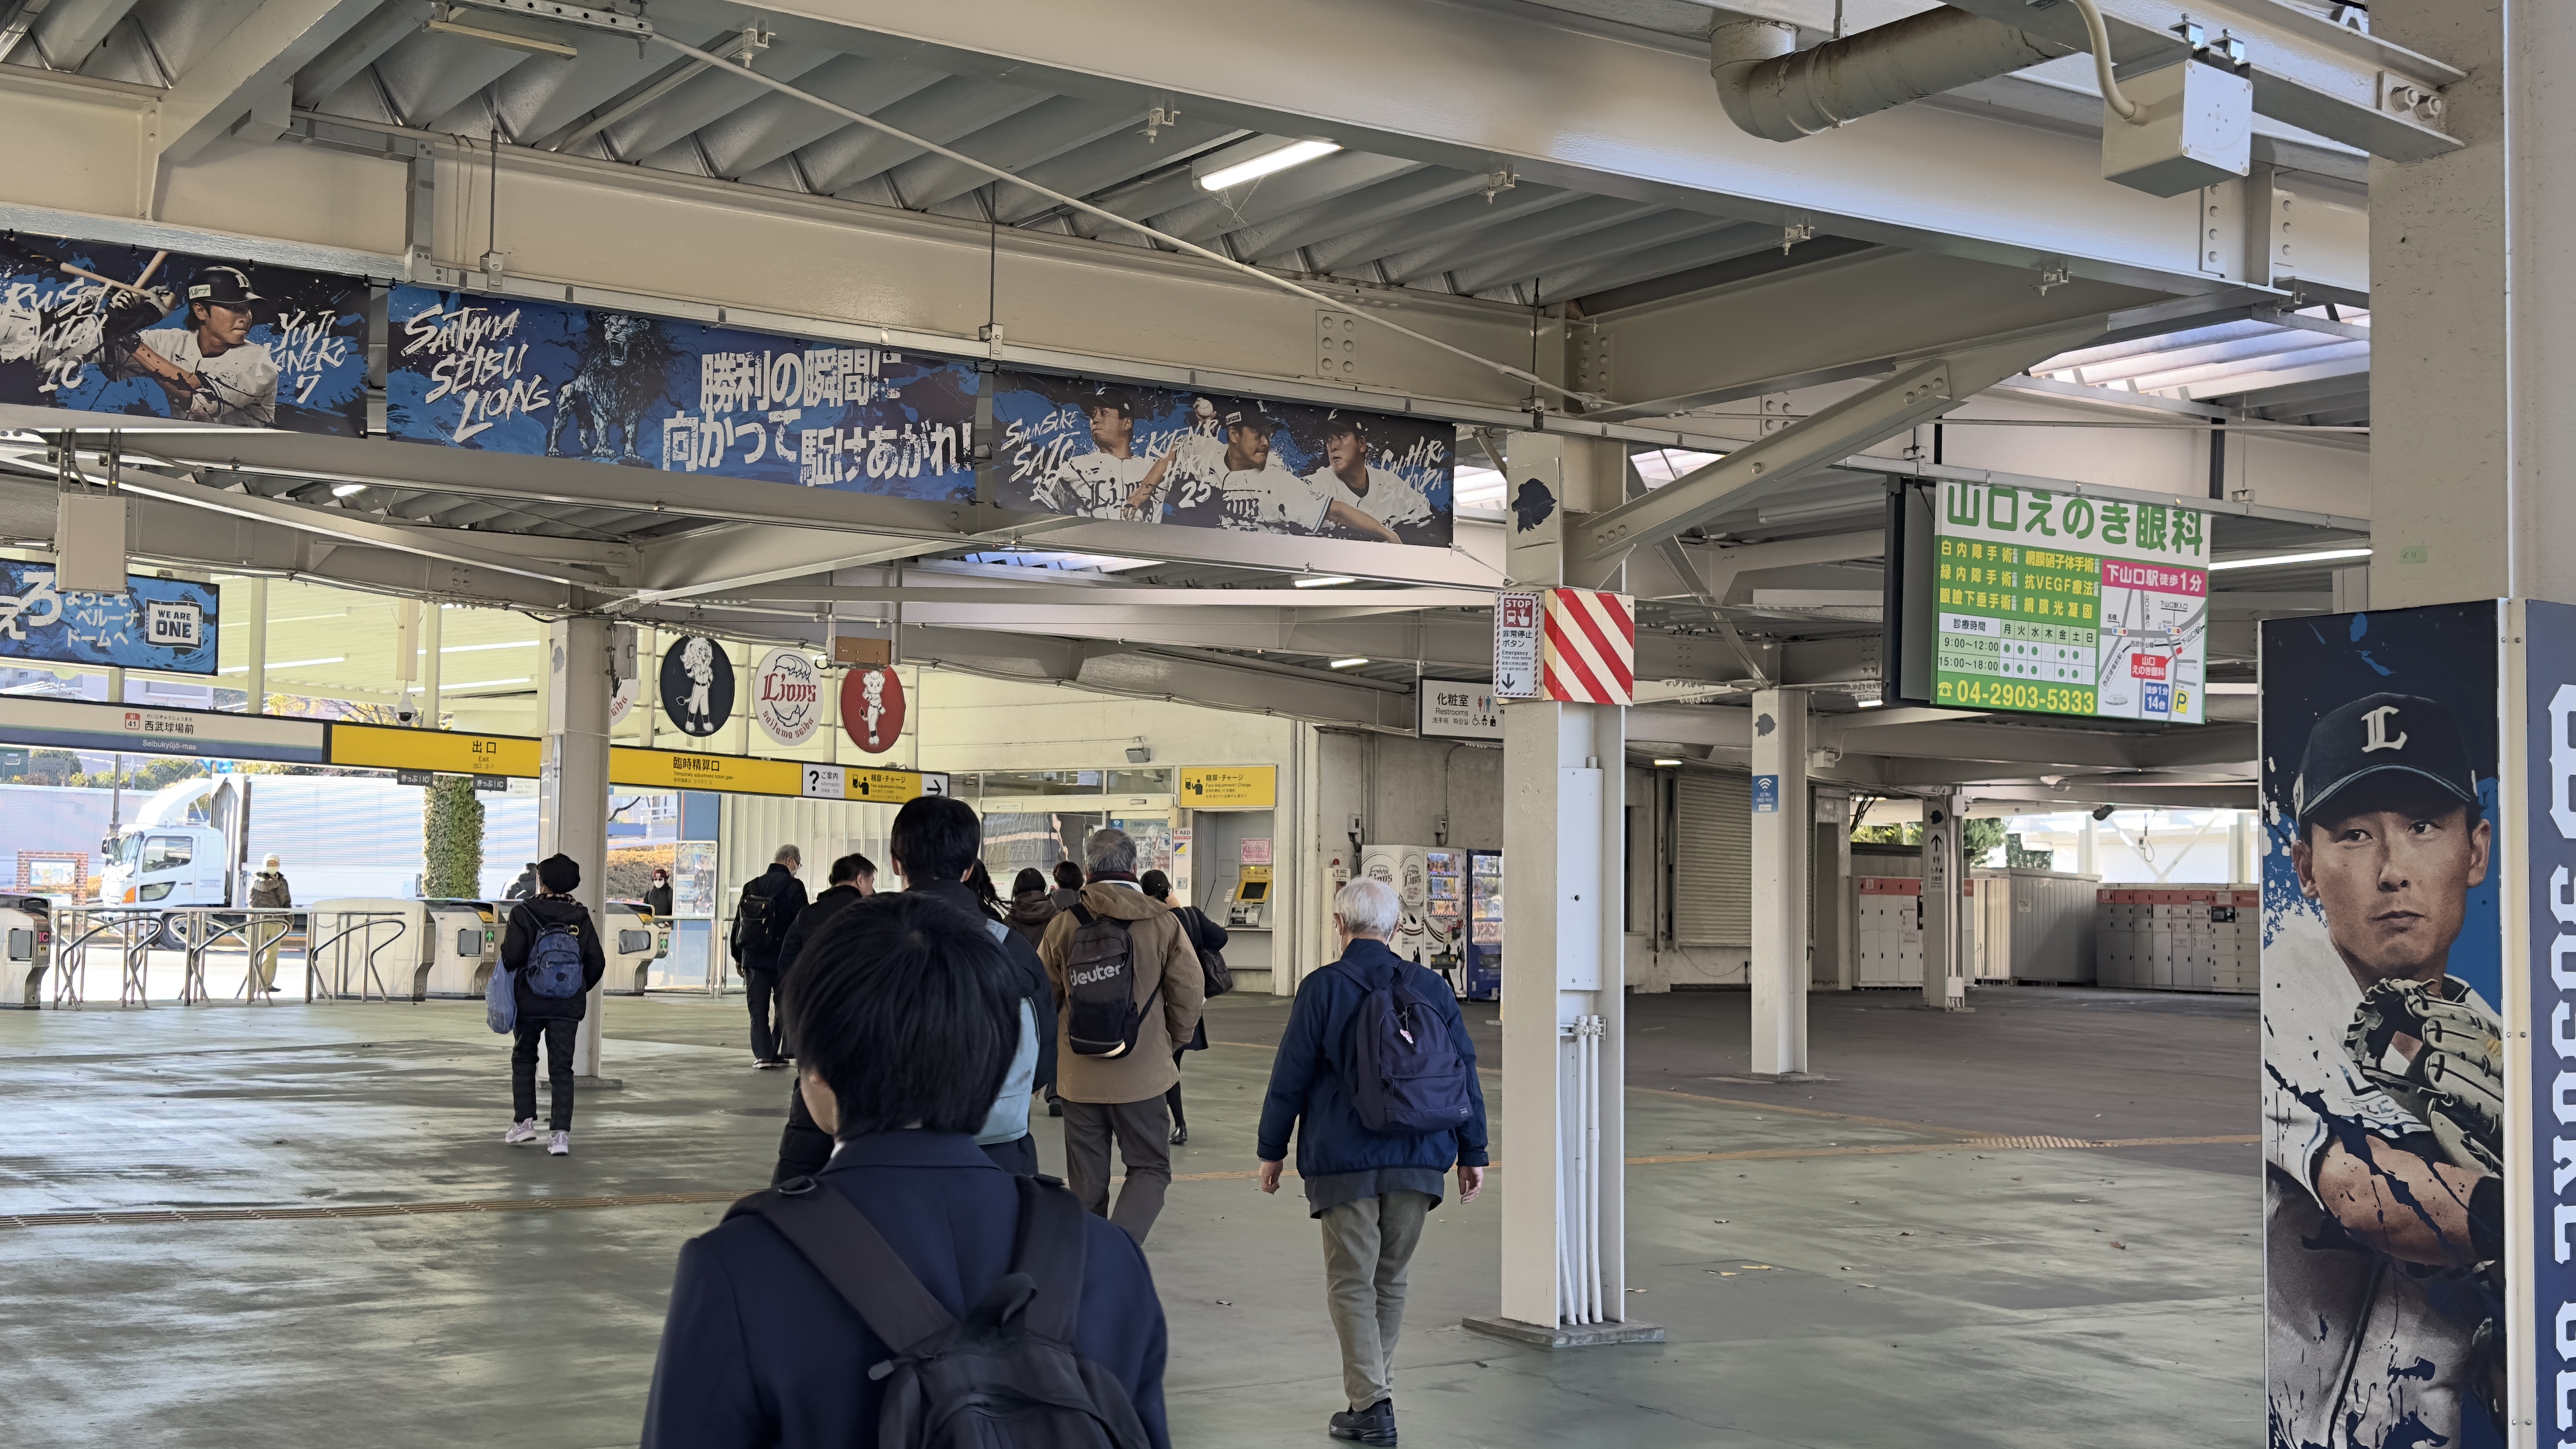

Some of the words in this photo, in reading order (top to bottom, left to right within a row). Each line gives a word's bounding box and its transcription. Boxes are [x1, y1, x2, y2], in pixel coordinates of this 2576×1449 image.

[400, 304, 520, 356] SAITAMA
[425, 343, 529, 405] SEIBU
[700, 348, 902, 413] 勝利の瞬間に
[296, 374, 322, 404] 7
[452, 375, 551, 443] LIONS
[662, 408, 801, 472] 向かって
[1009, 431, 1080, 483] SATO
[1178, 477, 1211, 509] 25
[1948, 480, 2203, 557] 山口えのき眼科
[1941, 540, 2012, 564] 白内障手術
[2025, 550, 2094, 573] 網膜硝子体手術
[1940, 563, 2012, 587] 緑内障手術
[2025, 573, 2093, 596] 抗VEGF療法
[2106, 564, 2202, 592] 下山口駅徒歩1分
[158, 609, 171, 619] WE
[174, 611, 191, 621] ARE
[1505, 600, 1531, 608] STOP
[76, 608, 140, 627] ベルーナ
[156, 620, 192, 638] ONE
[1953, 618, 1986, 632] 診療時間
[2004, 624, 2011, 634] 月
[2017, 625, 2025, 636] 火
[2031, 628, 2039, 637] 水
[2045, 629, 2053, 637] 木
[2059, 630, 2066, 640] 金
[2073, 632, 2079, 641] 土
[2087, 633, 2093, 642] 日
[2132, 665, 2165, 677] えのき眼科
[2141, 656, 2155, 666] 山口
[1437, 693, 1469, 707] 化粧室
[1957, 680, 2094, 714] 04-2903-5333
[2146, 685, 2168, 696] 徒歩1分
[1435, 707, 1469, 716] Restrooms
[2148, 696, 2166, 710] 14台
[145, 720, 194, 735] 西武球場前
[2361, 706, 2407, 753] L
[472, 740, 496, 754] 出口
[673, 756, 720, 771] 臨時精算口
[38, 932, 49, 942] IC
[1070, 964, 1121, 986] deuter
